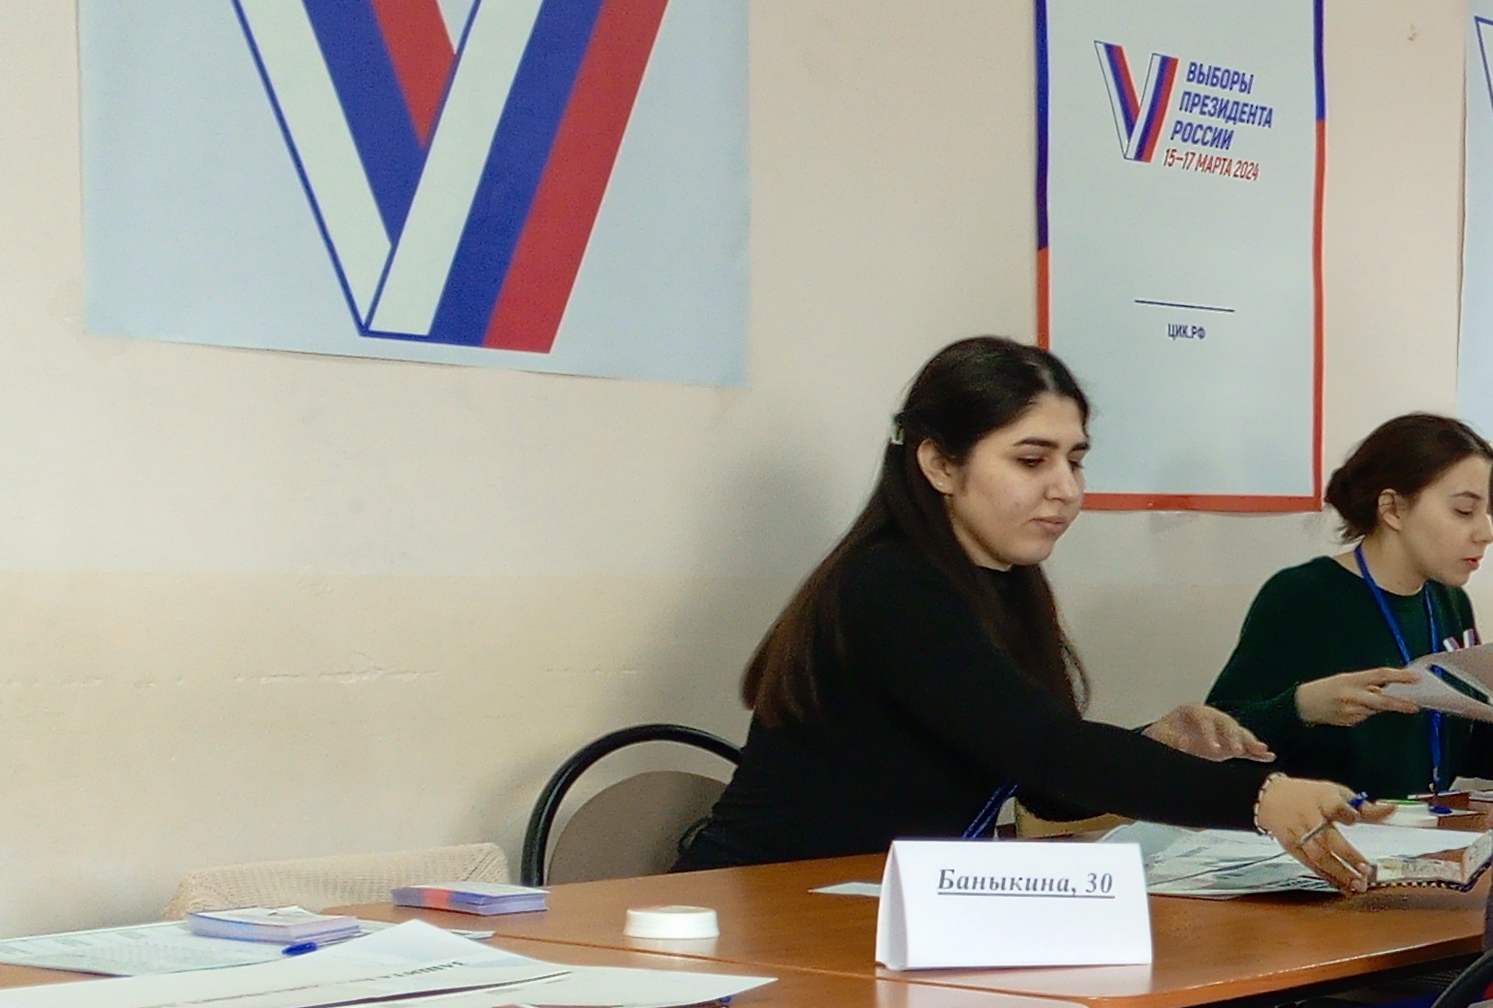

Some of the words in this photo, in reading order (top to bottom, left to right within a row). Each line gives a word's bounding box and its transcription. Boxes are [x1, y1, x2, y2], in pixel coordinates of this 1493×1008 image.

[1186, 61, 1254, 94] ВЫБОРЫ
[1179, 91, 1273, 128] ПРЕЗИДЕНТА
[1170, 120, 1234, 150] РОССИИ
[1163, 149, 1196, 172] 15–17
[1195, 153, 1232, 177] МАРТА
[1233, 161, 1260, 181] 2024
[1168, 323, 1205, 340] ЦИК.РФ
[938, 869, 1076, 897] Баныкина,
[1085, 873, 1113, 894] 30
